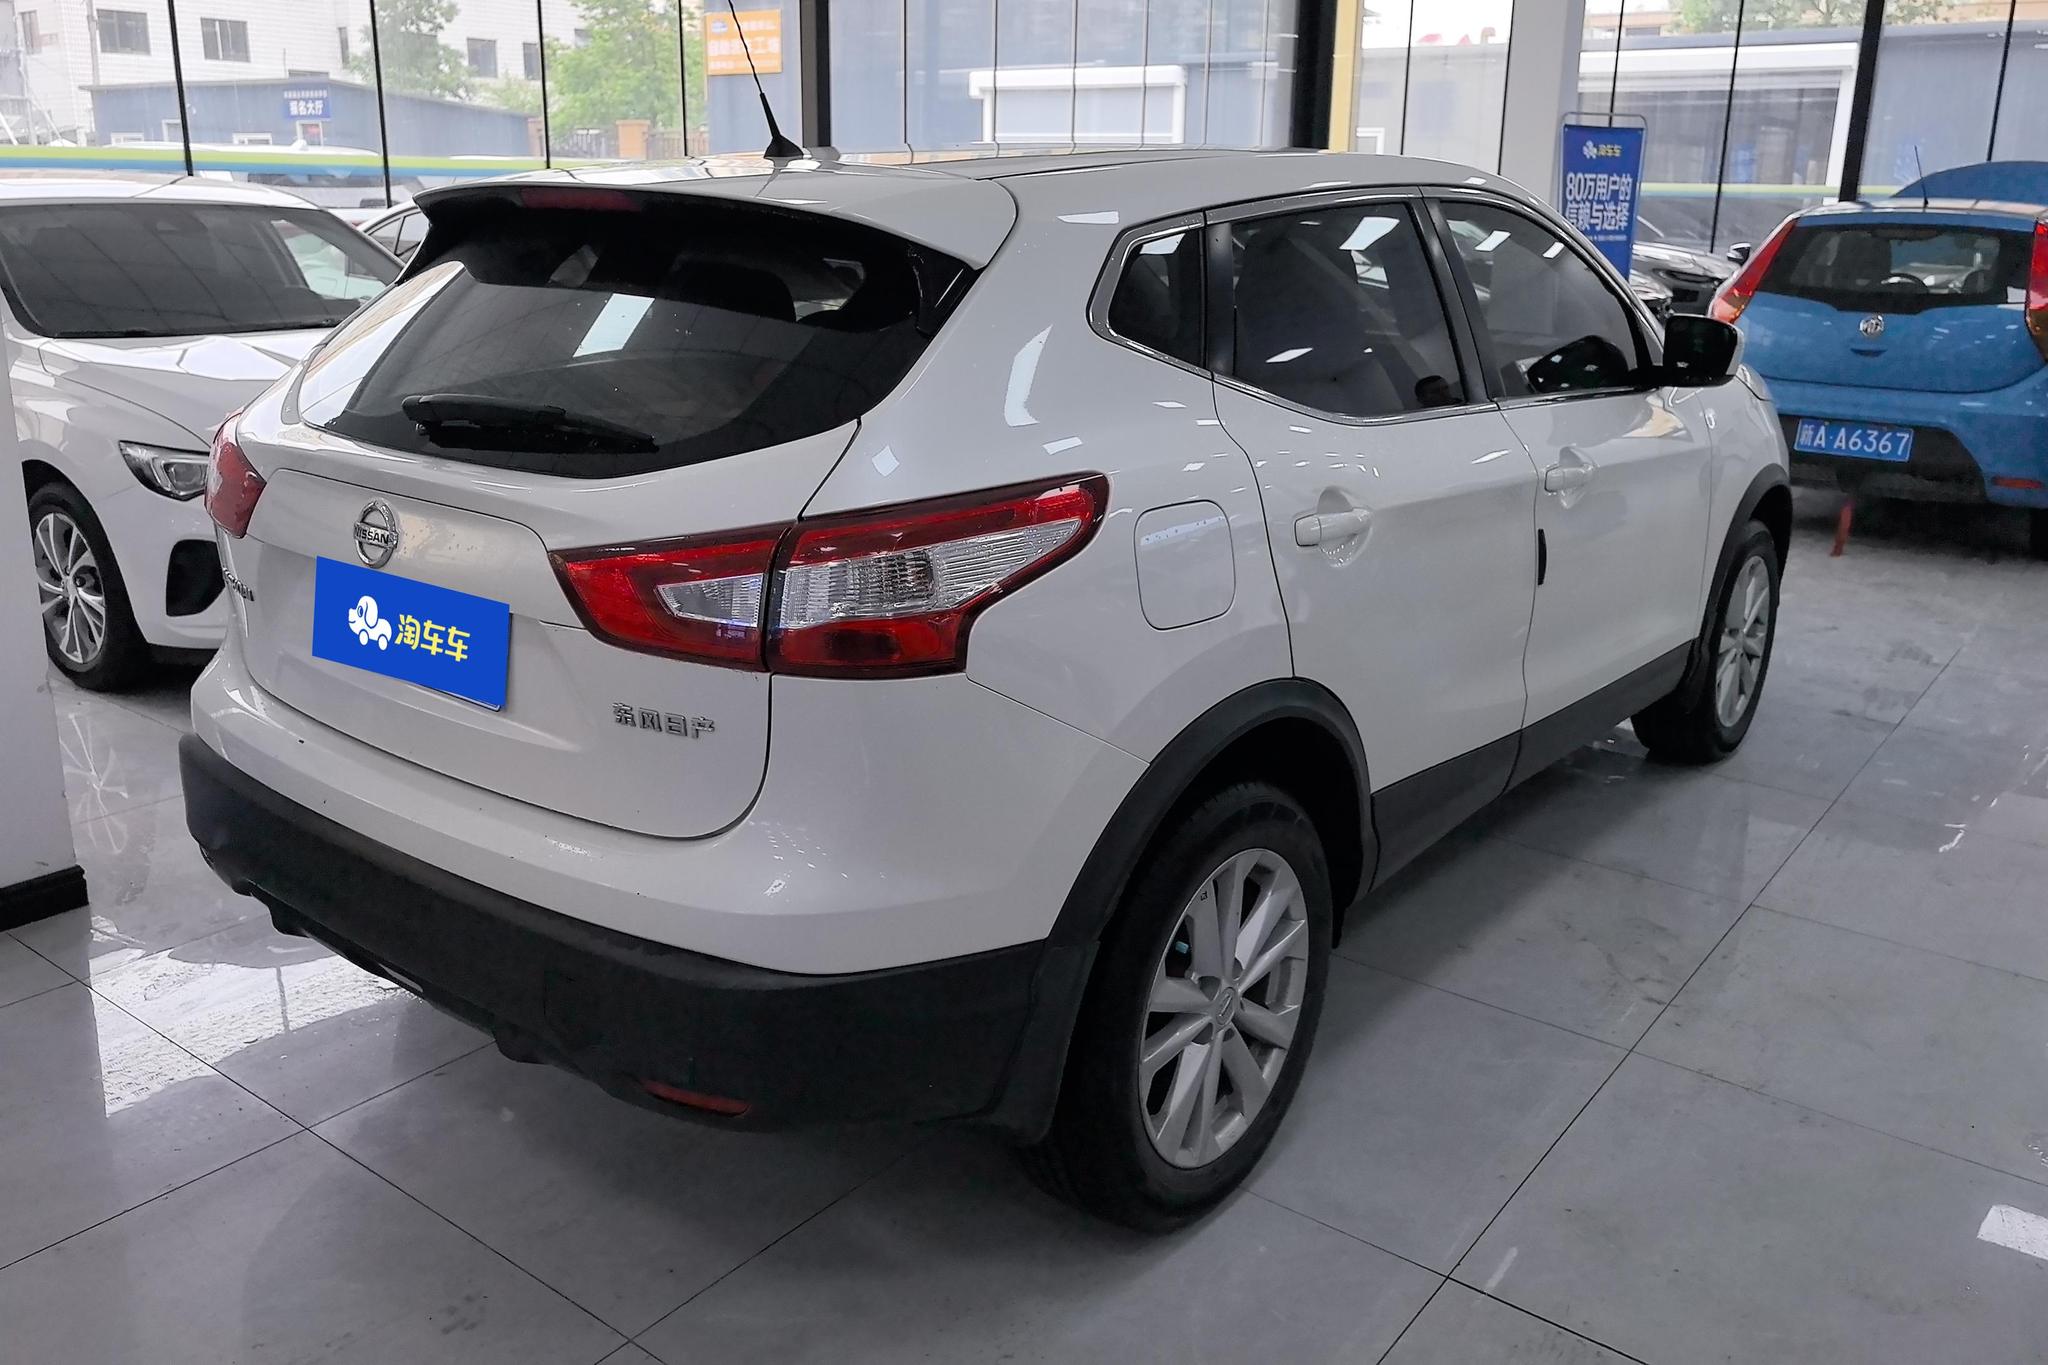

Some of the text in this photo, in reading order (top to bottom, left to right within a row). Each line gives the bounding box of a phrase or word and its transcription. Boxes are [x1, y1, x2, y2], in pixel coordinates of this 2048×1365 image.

[1566, 172, 1632, 201] 80万用户的
[1565, 201, 1630, 231] 信赖与选择
[355, 525, 390, 546] NISSAN
[612, 702, 715, 739] 东风日产
